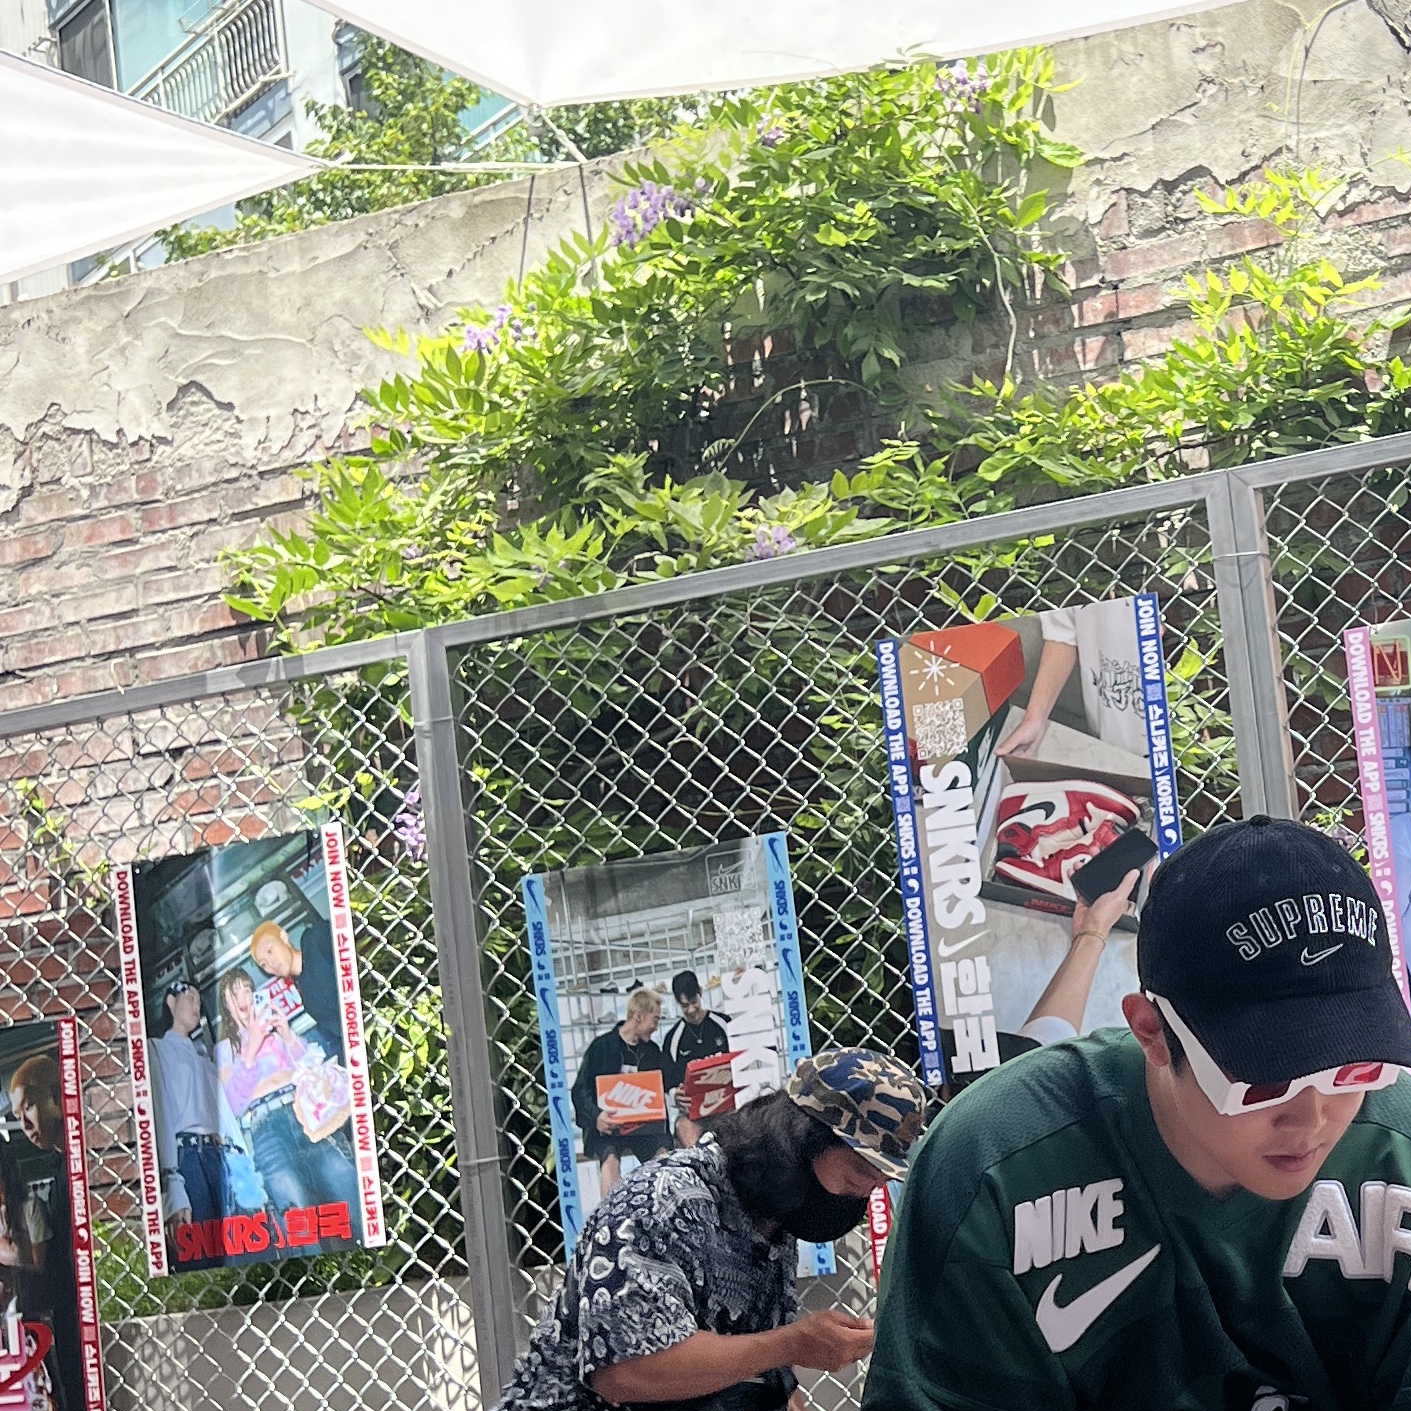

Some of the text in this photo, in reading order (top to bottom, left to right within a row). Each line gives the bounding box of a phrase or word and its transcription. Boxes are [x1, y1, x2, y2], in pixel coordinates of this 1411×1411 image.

[878, 641, 902, 730] DOWNLOAD
[1347, 631, 1372, 723] DOWNLOAD
[1137, 597, 1175, 826] JOIN NOW 스니커즈 KOREA
[888, 732, 905, 761] THE
[1358, 726, 1376, 756] THE
[891, 763, 909, 795] APP
[1361, 759, 1380, 793] APP
[896, 813, 916, 859] SNKRS
[1368, 811, 1389, 859] SNKRS
[115, 870, 134, 954] DOWNLOAD
[919, 760, 1001, 1074] SNKRS 한국
[1226, 893, 1378, 961] SUPREME
[905, 896, 929, 985] DOWNLOAD
[123, 958, 137, 984] THE
[126, 989, 140, 1018] APP
[915, 987, 933, 1016] THE
[59, 1020, 74, 1055] JOIN
[325, 830, 379, 1236] JOIN NOW 스니커즈 KOREA JOIN NOW 스니커즈
[919, 1019, 937, 1051] APP
[62, 1058, 77, 1096] NOW
[130, 1038, 146, 1081] SNKRS
[66, 1115, 83, 1174] 스니커즈
[138, 1119, 157, 1204] DOWNLOAD
[71, 1180, 86, 1226] KOREA
[146, 1209, 160, 1235] THE
[178, 1200, 352, 1263] SNKRS 한국
[1013, 1177, 1124, 1276] NIKE
[76, 1247, 90, 1282] JOIN
[149, 1240, 163, 1270] APP
[79, 1285, 94, 1323] NOW
[84, 1343, 100, 1401] 스니커즈
